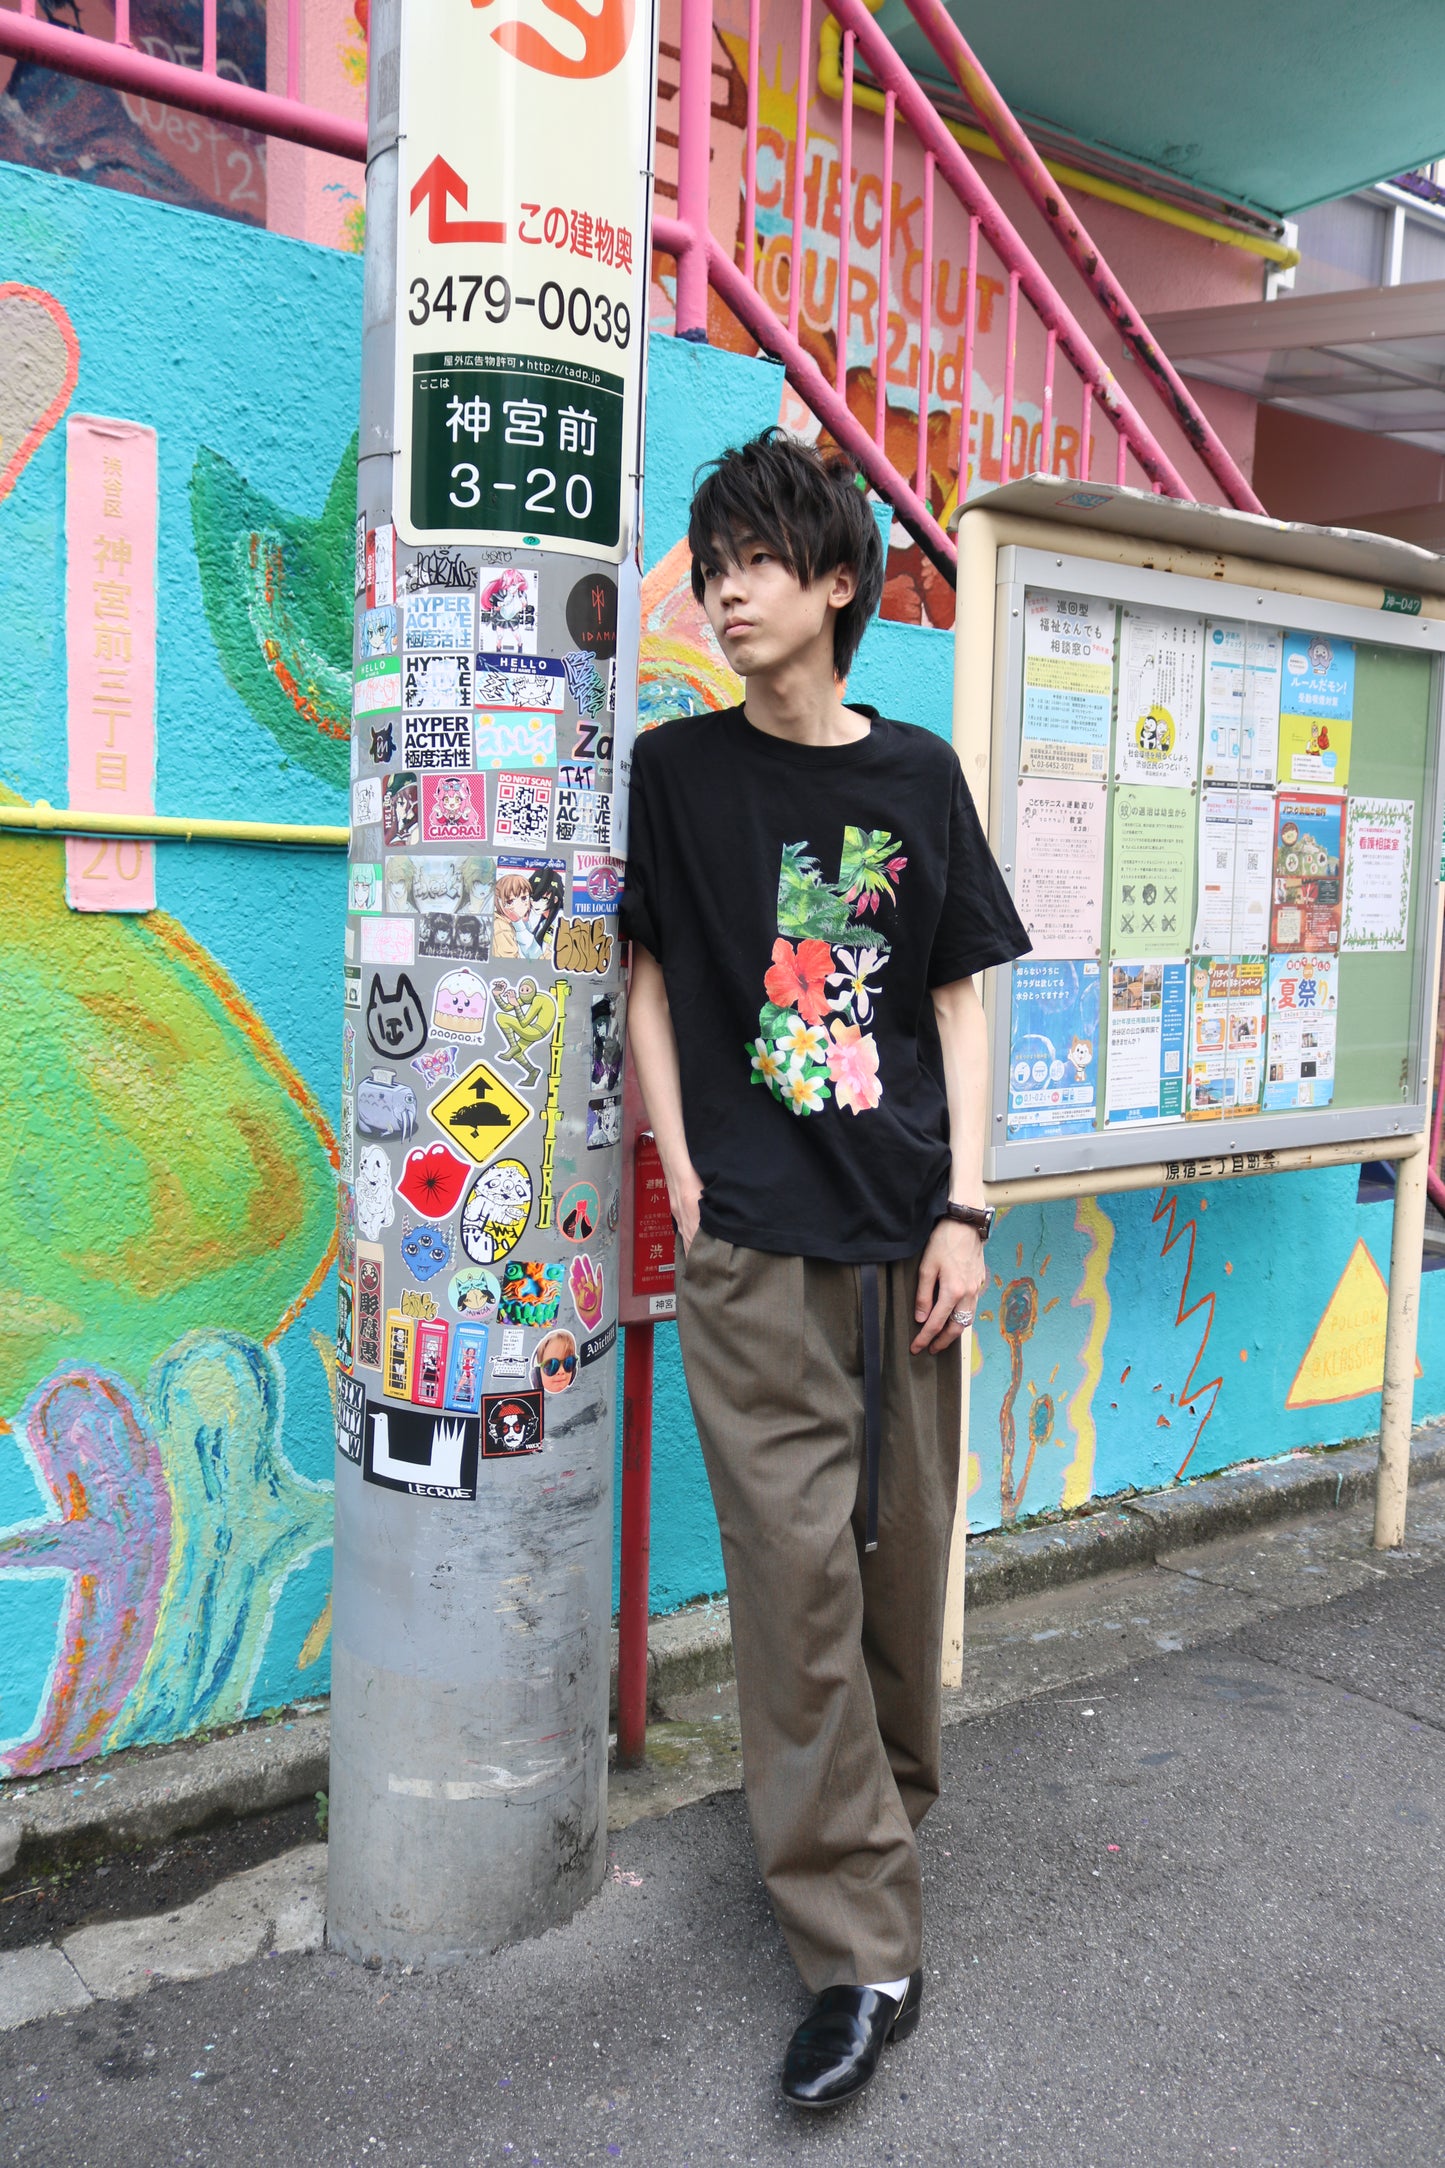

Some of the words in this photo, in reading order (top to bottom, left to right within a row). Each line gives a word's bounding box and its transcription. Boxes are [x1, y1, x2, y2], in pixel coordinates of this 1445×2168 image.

[518, 203, 632, 275] この建物奥
[408, 275, 631, 350] 3479-0039
[443, 355, 517, 368] 屋外広告物許可
[527, 360, 601, 384] http://tadp.jp
[419, 377, 450, 390] ここは
[446, 395, 598, 456] 神宮前
[102, 456, 123, 518] 渋谷区
[449, 462, 593, 519] 3-20
[407, 596, 471, 613] HYPER
[1056, 600, 1089, 617] 巡回型
[1040, 616, 1102, 639] 福祉なんでも
[1050, 639, 1091, 656] 相談窓口
[92, 534, 133, 791] 神宮前三丁目
[361, 660, 386, 674] HELLO
[500, 657, 548, 670] HELLO
[405, 716, 469, 733] HYPER
[404, 732, 471, 749] ACTIVE
[404, 748, 471, 768] 極度活性
[499, 774, 512, 783] DO
[513, 775, 531, 785] NOT
[532, 777, 552, 787] SCAN
[560, 765, 593, 790] T4T
[1359, 836, 1400, 851] 看護相談室
[82, 838, 143, 880] 20
[575, 903, 591, 913] THE
[1016, 967, 1060, 976] 知らないうちに
[1278, 978, 1329, 1010] 夏祭り
[430, 1028, 483, 1044] paopao.it
